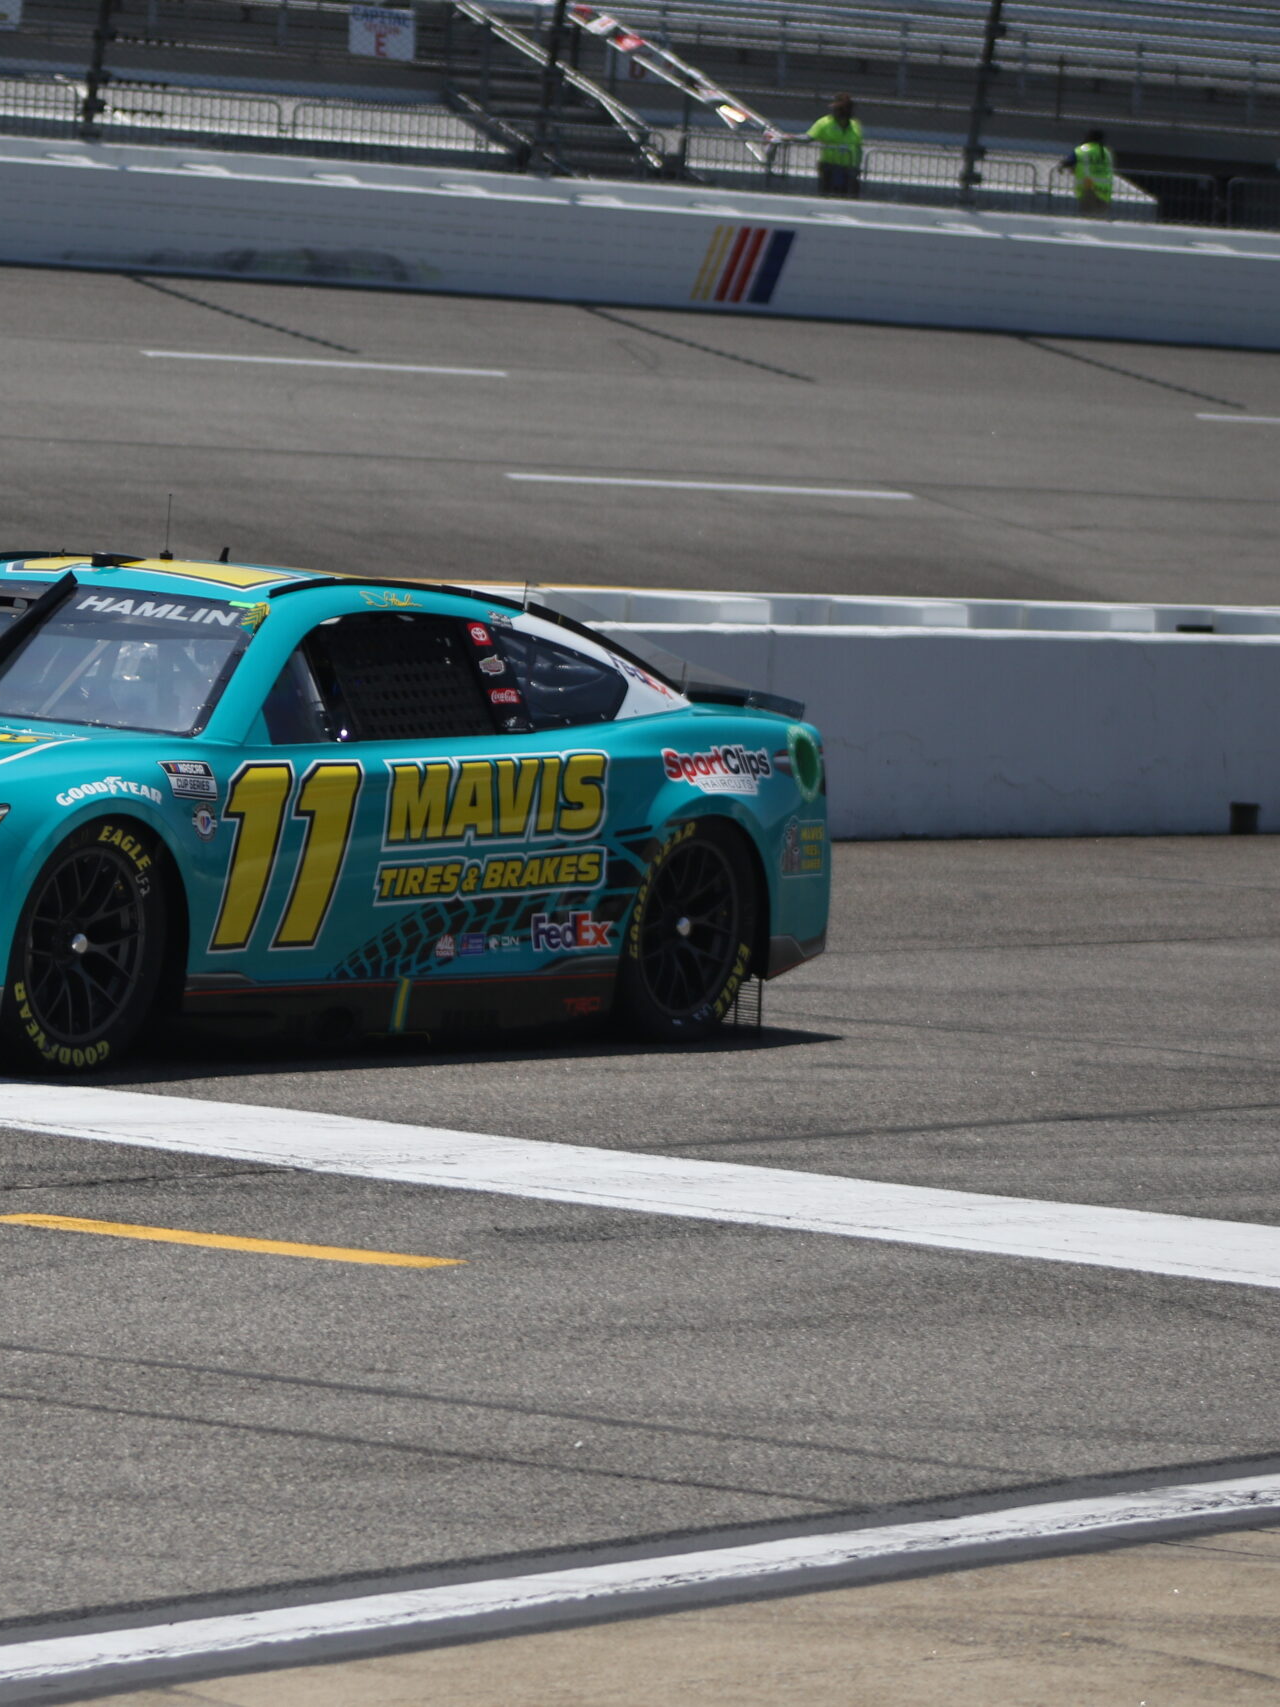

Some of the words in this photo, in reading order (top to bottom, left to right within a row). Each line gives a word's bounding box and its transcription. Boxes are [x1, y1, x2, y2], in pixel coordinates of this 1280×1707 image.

[76, 595, 240, 627] HAMLIN
[176, 778, 189, 789] CUP
[190, 779, 210, 791] SERIES
[178, 763, 206, 775] NASCAR
[701, 778, 754, 790] HAIRCUTS
[56, 776, 162, 805] GOODYEAR
[384, 751, 609, 847] MAVIS
[97, 825, 153, 871] EAGLE
[208, 760, 365, 953] 11
[379, 863, 462, 898] TIRES
[461, 866, 480, 893] &
[481, 852, 602, 891] BRAKES
[532, 912, 613, 951] FedEx
[14, 982, 111, 1067] GOODYEAR
